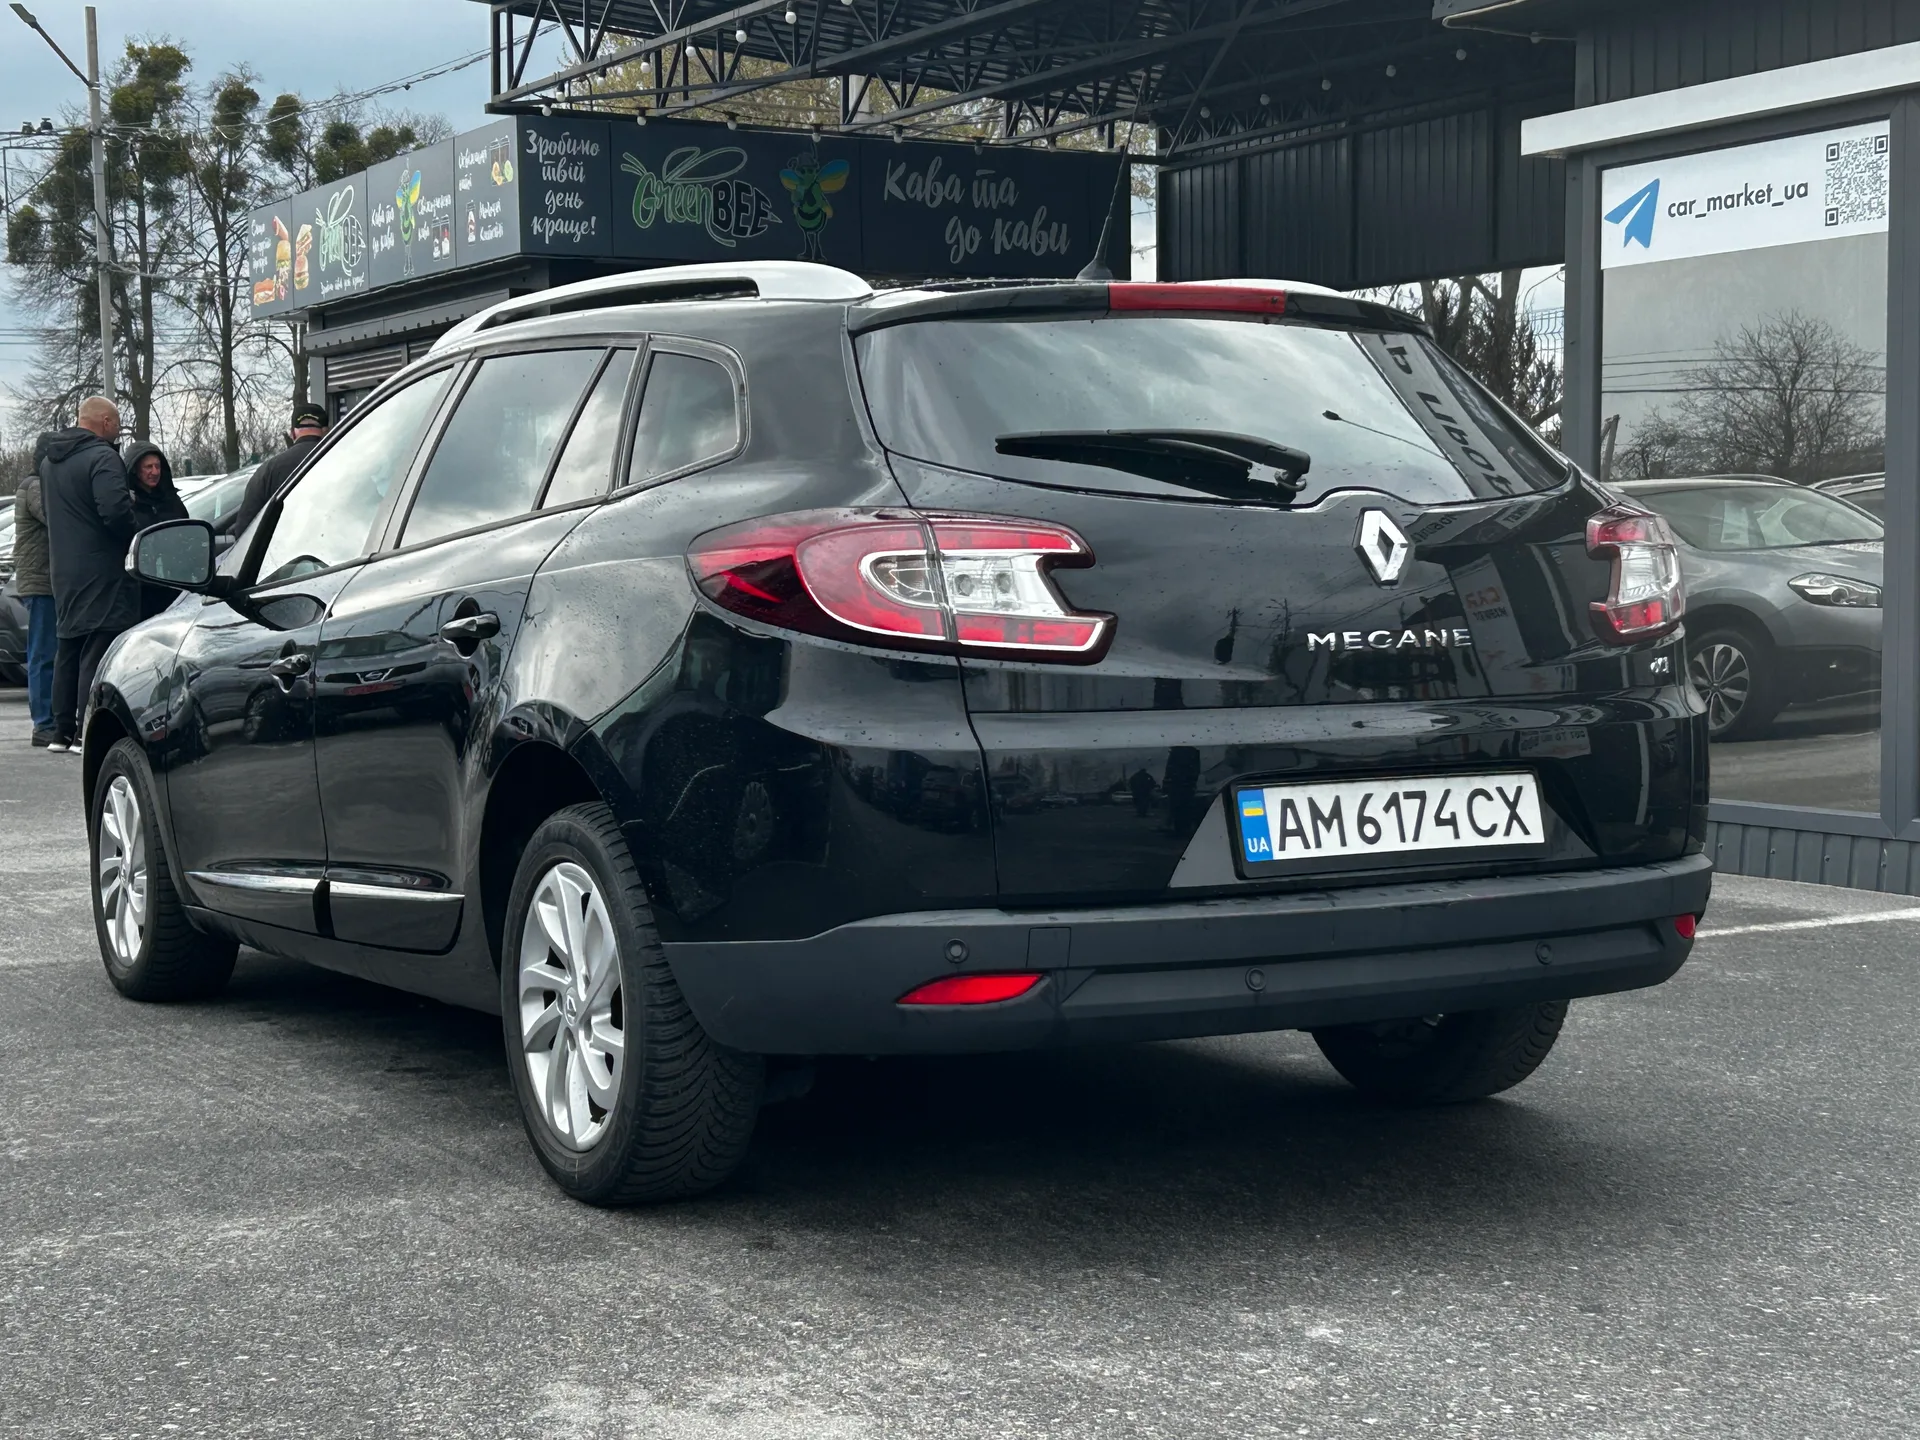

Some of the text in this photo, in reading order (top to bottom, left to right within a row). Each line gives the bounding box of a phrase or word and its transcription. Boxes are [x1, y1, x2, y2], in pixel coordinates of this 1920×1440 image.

[526, 129, 600, 164] Зробимо
[542, 157, 586, 183] твій
[884, 156, 1019, 209] Кава та
[545, 189, 584, 215] день
[1667, 181, 1809, 219] car_market_ua
[531, 215, 597, 244] краще!
[945, 205, 1070, 264] до кави
[1306, 627, 1472, 652] MEGANE
[1247, 837, 1270, 854] UA
